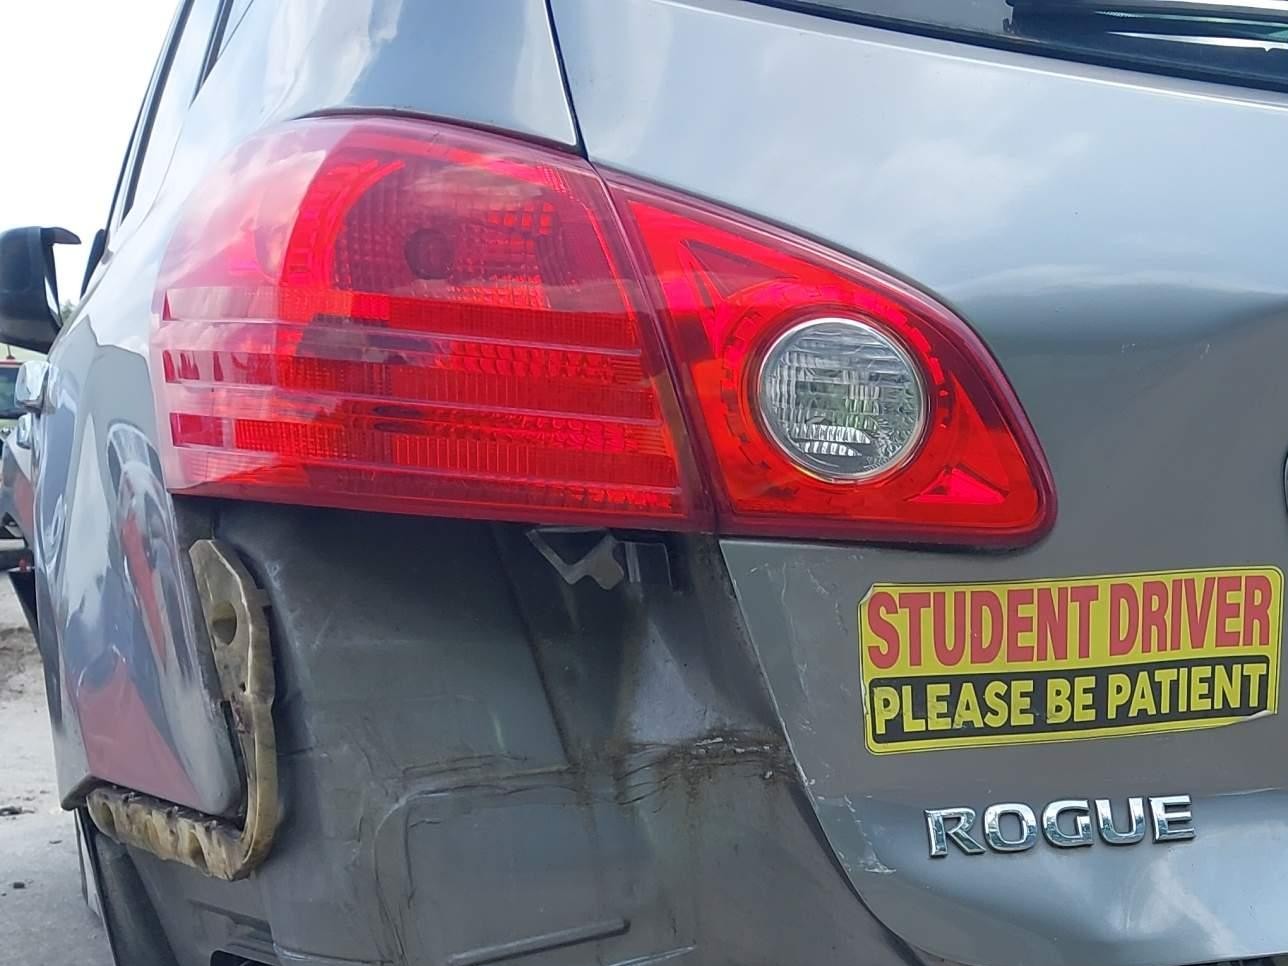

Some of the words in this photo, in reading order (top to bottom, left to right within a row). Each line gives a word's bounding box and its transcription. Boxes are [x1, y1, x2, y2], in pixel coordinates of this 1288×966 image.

[867, 586, 1099, 668] STUDENT
[1109, 575, 1272, 657] DRIVER
[872, 680, 1034, 734] PLEASE
[1046, 676, 1096, 724] BE
[1106, 663, 1267, 720] PATIENT
[925, 794, 1196, 858] ROGUE
